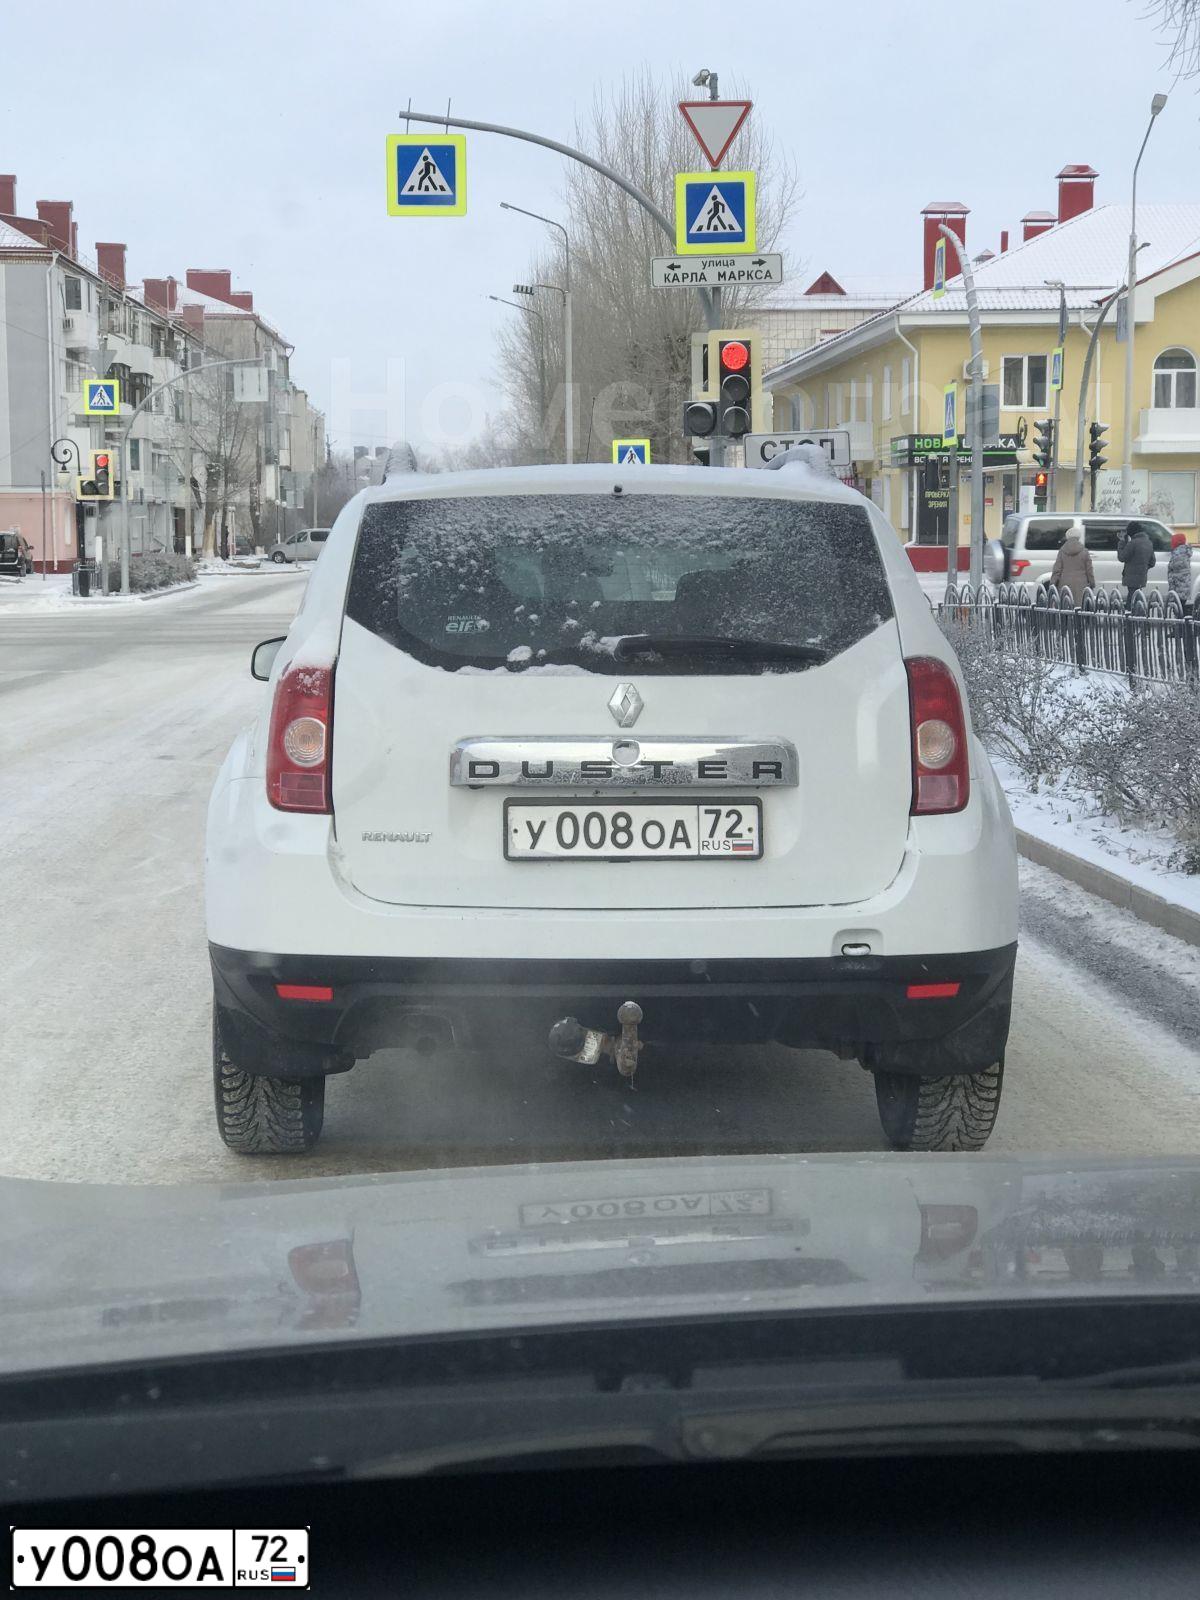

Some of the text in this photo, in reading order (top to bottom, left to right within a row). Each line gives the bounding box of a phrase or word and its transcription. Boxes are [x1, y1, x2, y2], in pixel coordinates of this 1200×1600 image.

[702, 259, 735, 269] улица
[664, 270, 773, 283] КАРЛА МАРКСА
[760, 438, 835, 463] СТП
[468, 760, 784, 779] DUSTER
[703, 808, 743, 839] 72
[361, 831, 433, 843] RENAULT
[701, 840, 731, 851] RUS
